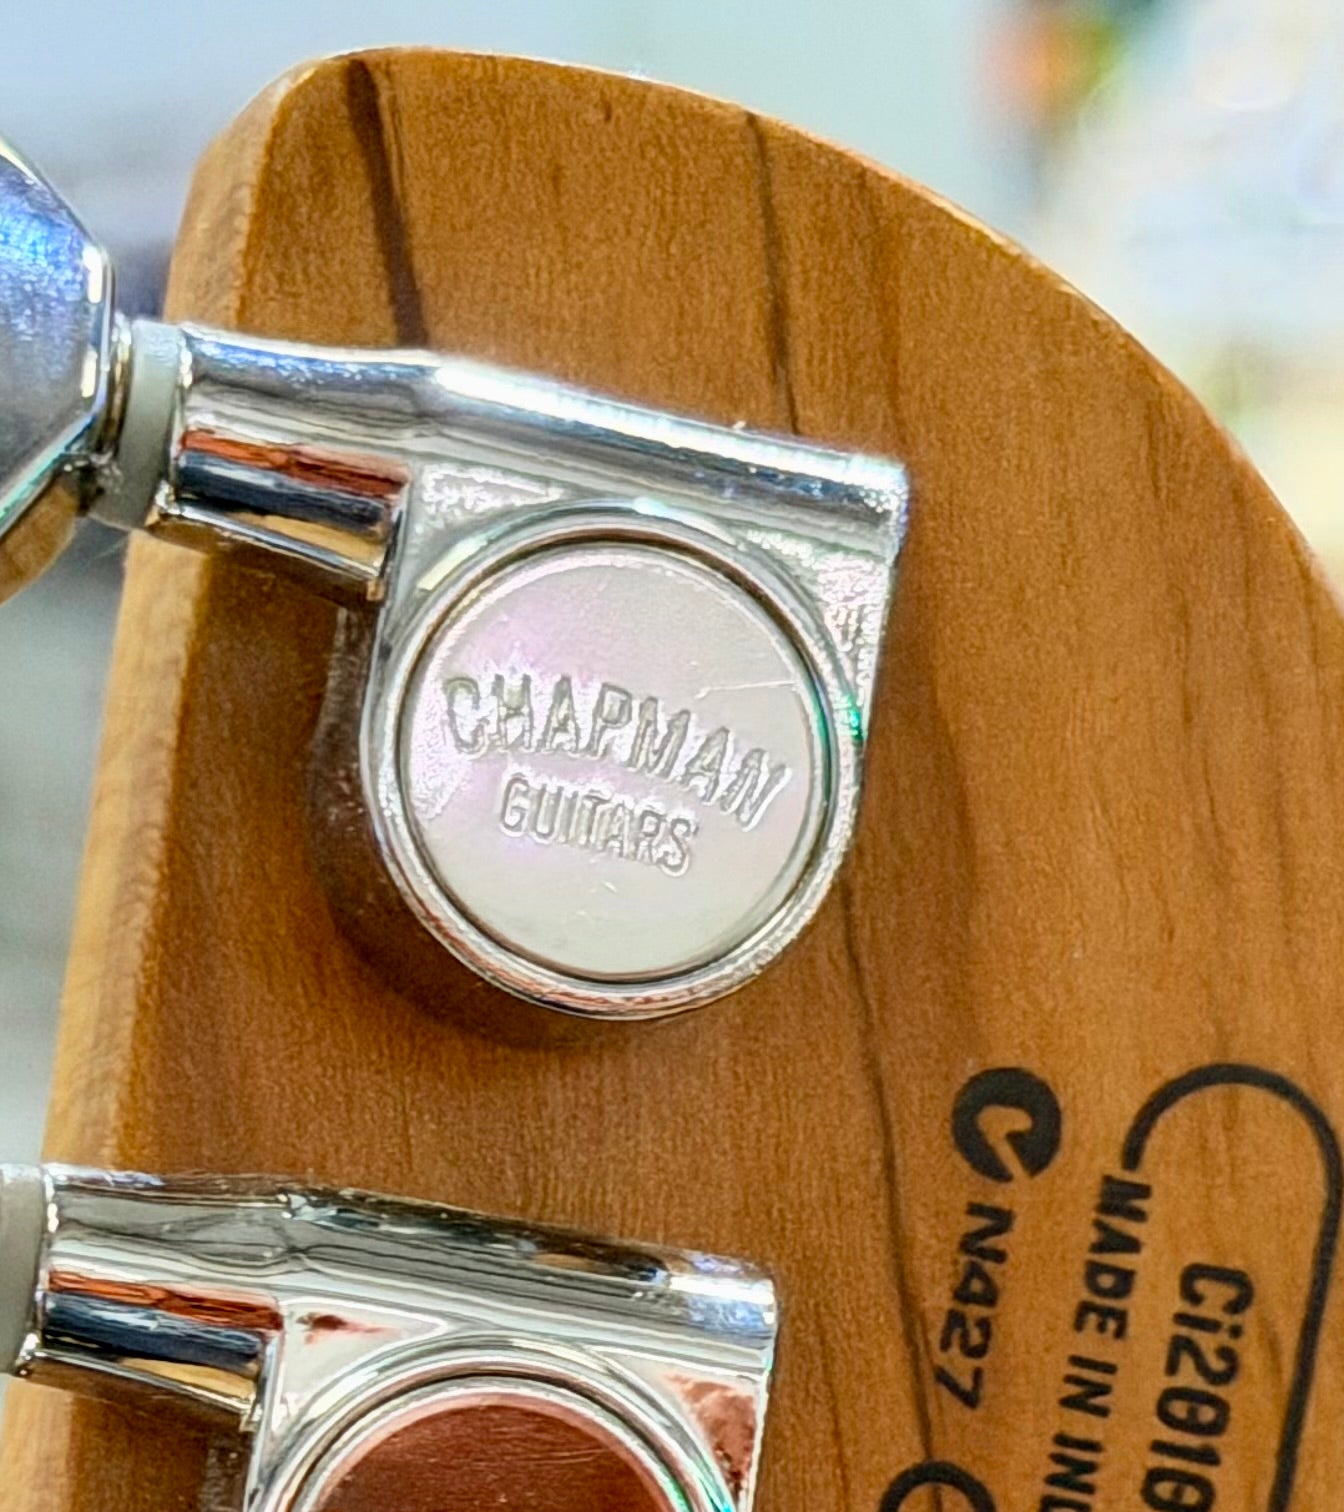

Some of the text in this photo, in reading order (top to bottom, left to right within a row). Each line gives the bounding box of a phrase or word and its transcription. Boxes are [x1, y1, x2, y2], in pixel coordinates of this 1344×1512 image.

[443, 673, 792, 831] CHAPMAN
[500, 772, 699, 877] GUITARS
[932, 1201, 1015, 1410] N427
[1073, 1173, 1153, 1341] MADE
[1059, 1353, 1118, 1419] IN
